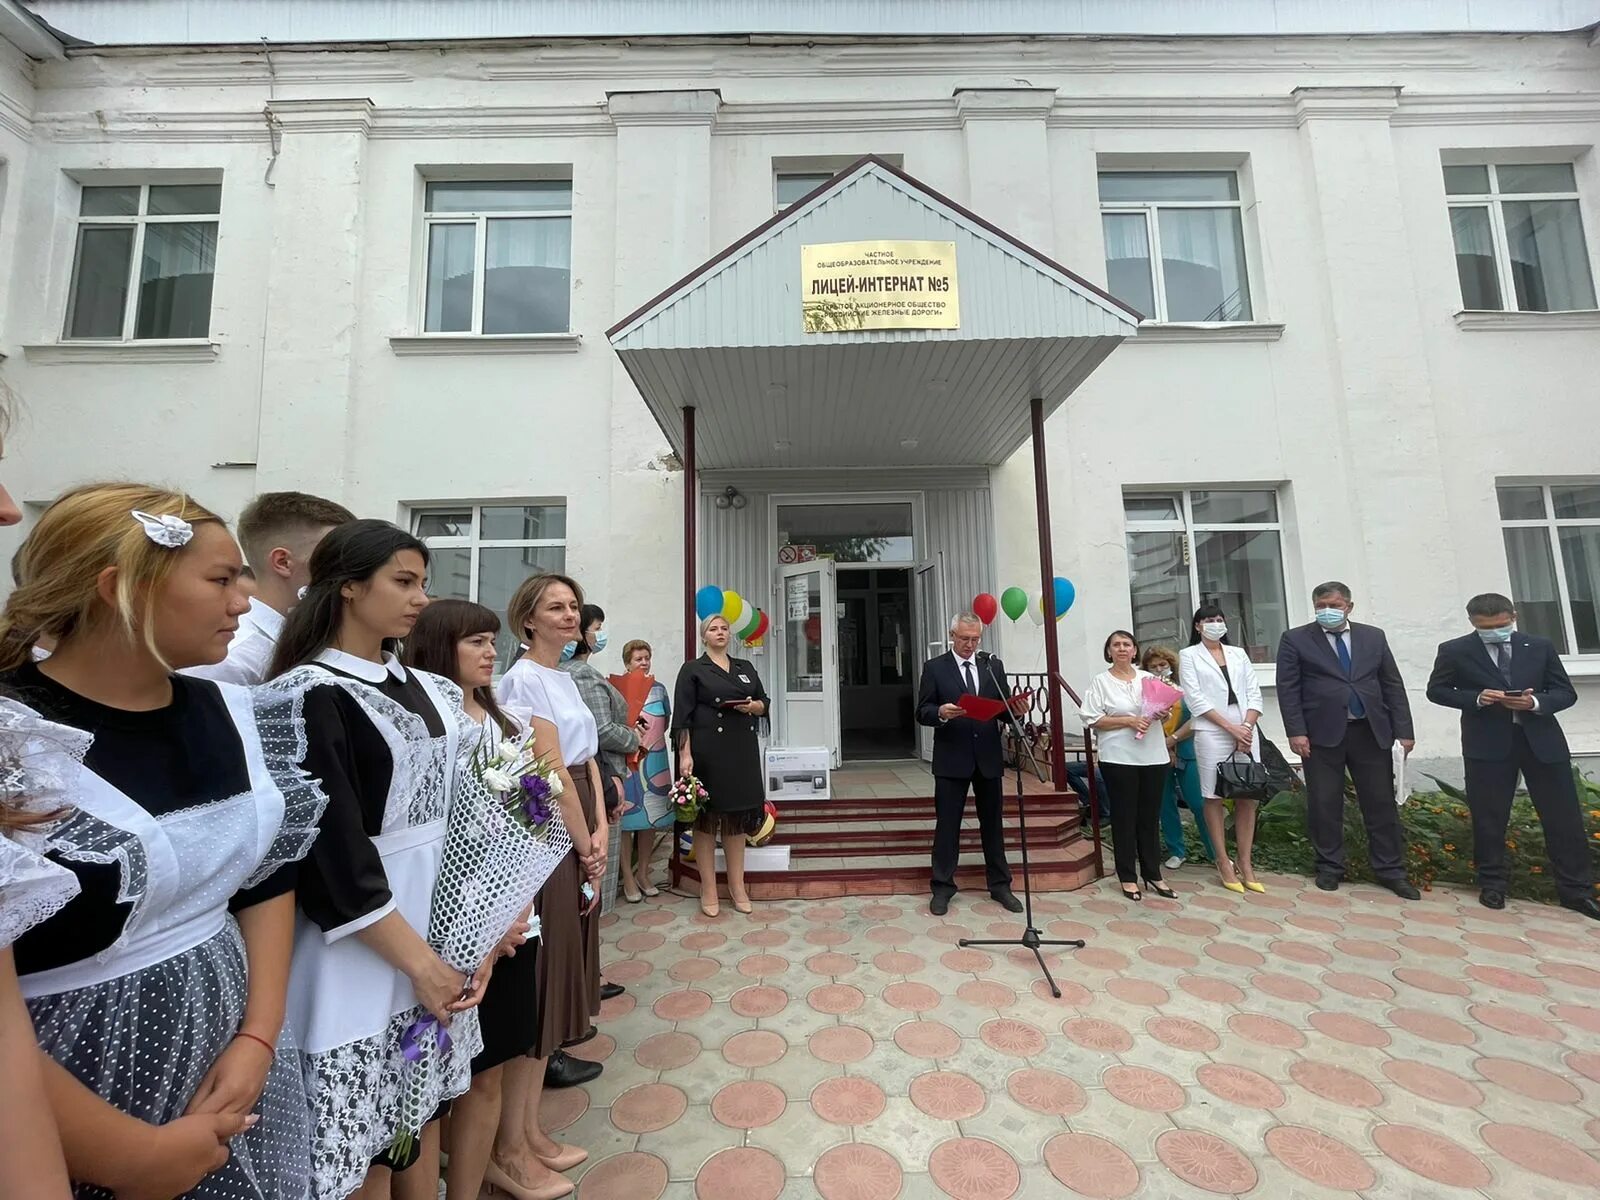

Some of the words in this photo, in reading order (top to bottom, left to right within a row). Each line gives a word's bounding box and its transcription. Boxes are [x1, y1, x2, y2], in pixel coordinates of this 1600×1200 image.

[817, 259, 900, 269] ОБЩЕОБРАЗОВАТЕЛЬНОЕ
[812, 274, 924, 296] ЛИЦЕЙ-ИНТЕРНАТ
[928, 276, 949, 292] №5
[816, 303, 853, 311] ОТКРЫТОЕ
[855, 301, 906, 310] АКЦИОНЕРНОЕ
